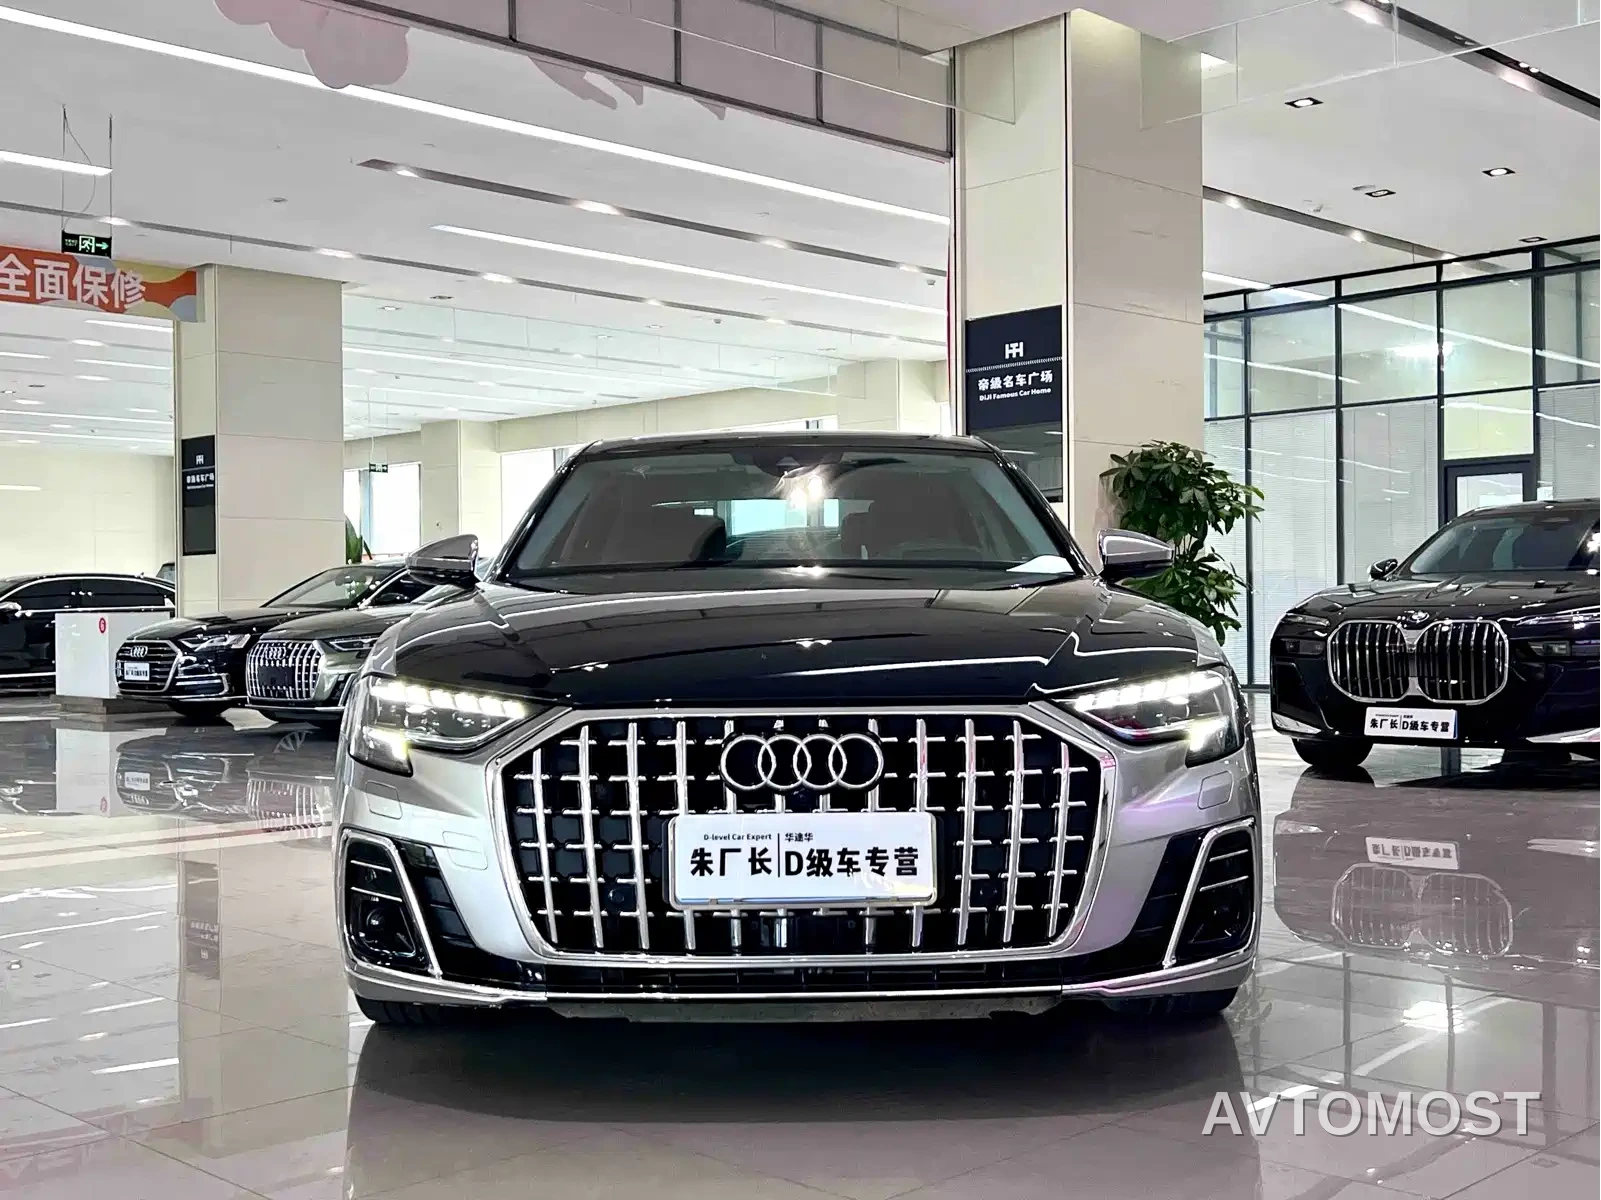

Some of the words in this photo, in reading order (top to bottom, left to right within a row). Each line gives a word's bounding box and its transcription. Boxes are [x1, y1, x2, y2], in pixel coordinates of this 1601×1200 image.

[0, 253, 146, 309] 全面保修
[993, 391, 1018, 399] Famous
[703, 833, 731, 841] D-level
[732, 833, 745, 841] Car
[746, 833, 772, 841] Expert
[690, 847, 773, 877] 朱厂长
[784, 847, 919, 877] D级车专营
